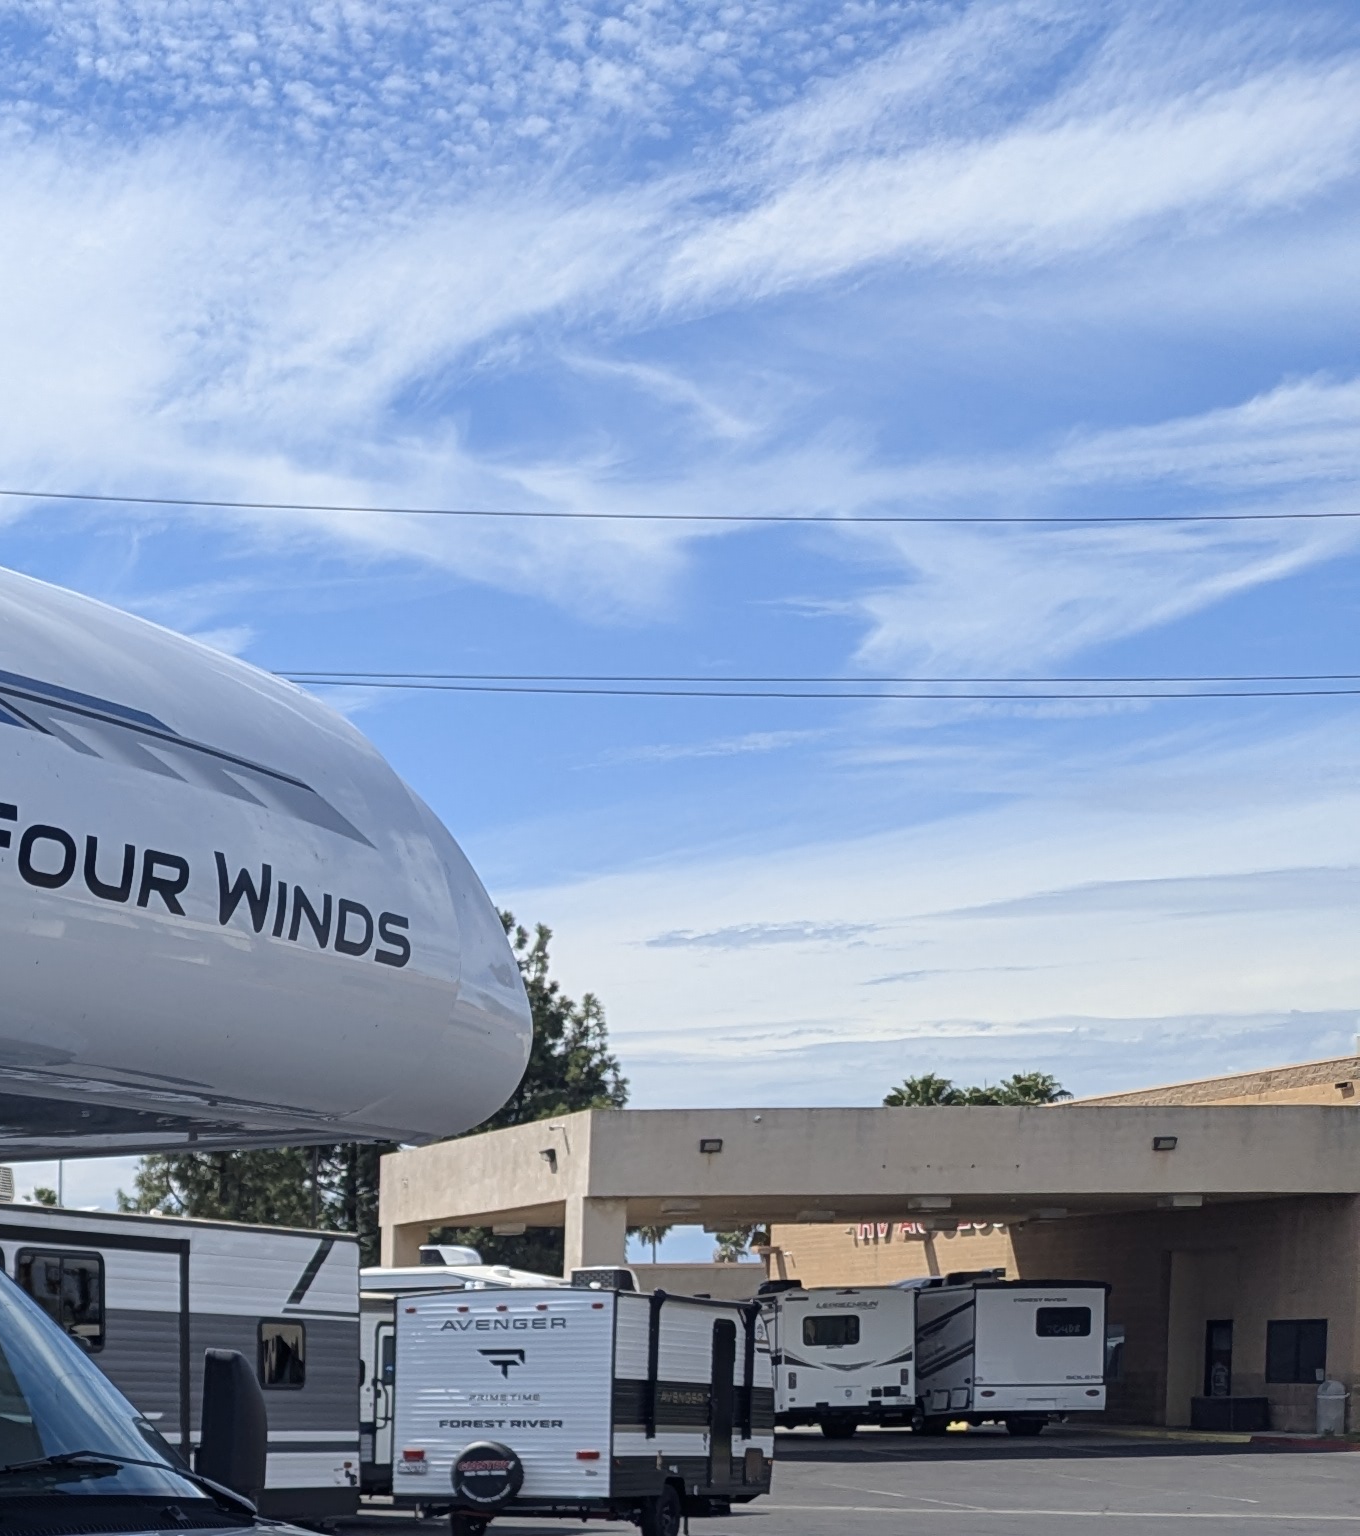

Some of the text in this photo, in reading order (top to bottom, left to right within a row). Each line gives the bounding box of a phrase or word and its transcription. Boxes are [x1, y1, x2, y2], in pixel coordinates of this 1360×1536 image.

[214, 851, 411, 968] WINDS
[440, 1317, 567, 1331] AVENGER
[438, 1419, 563, 1428] FOREST RIVER
